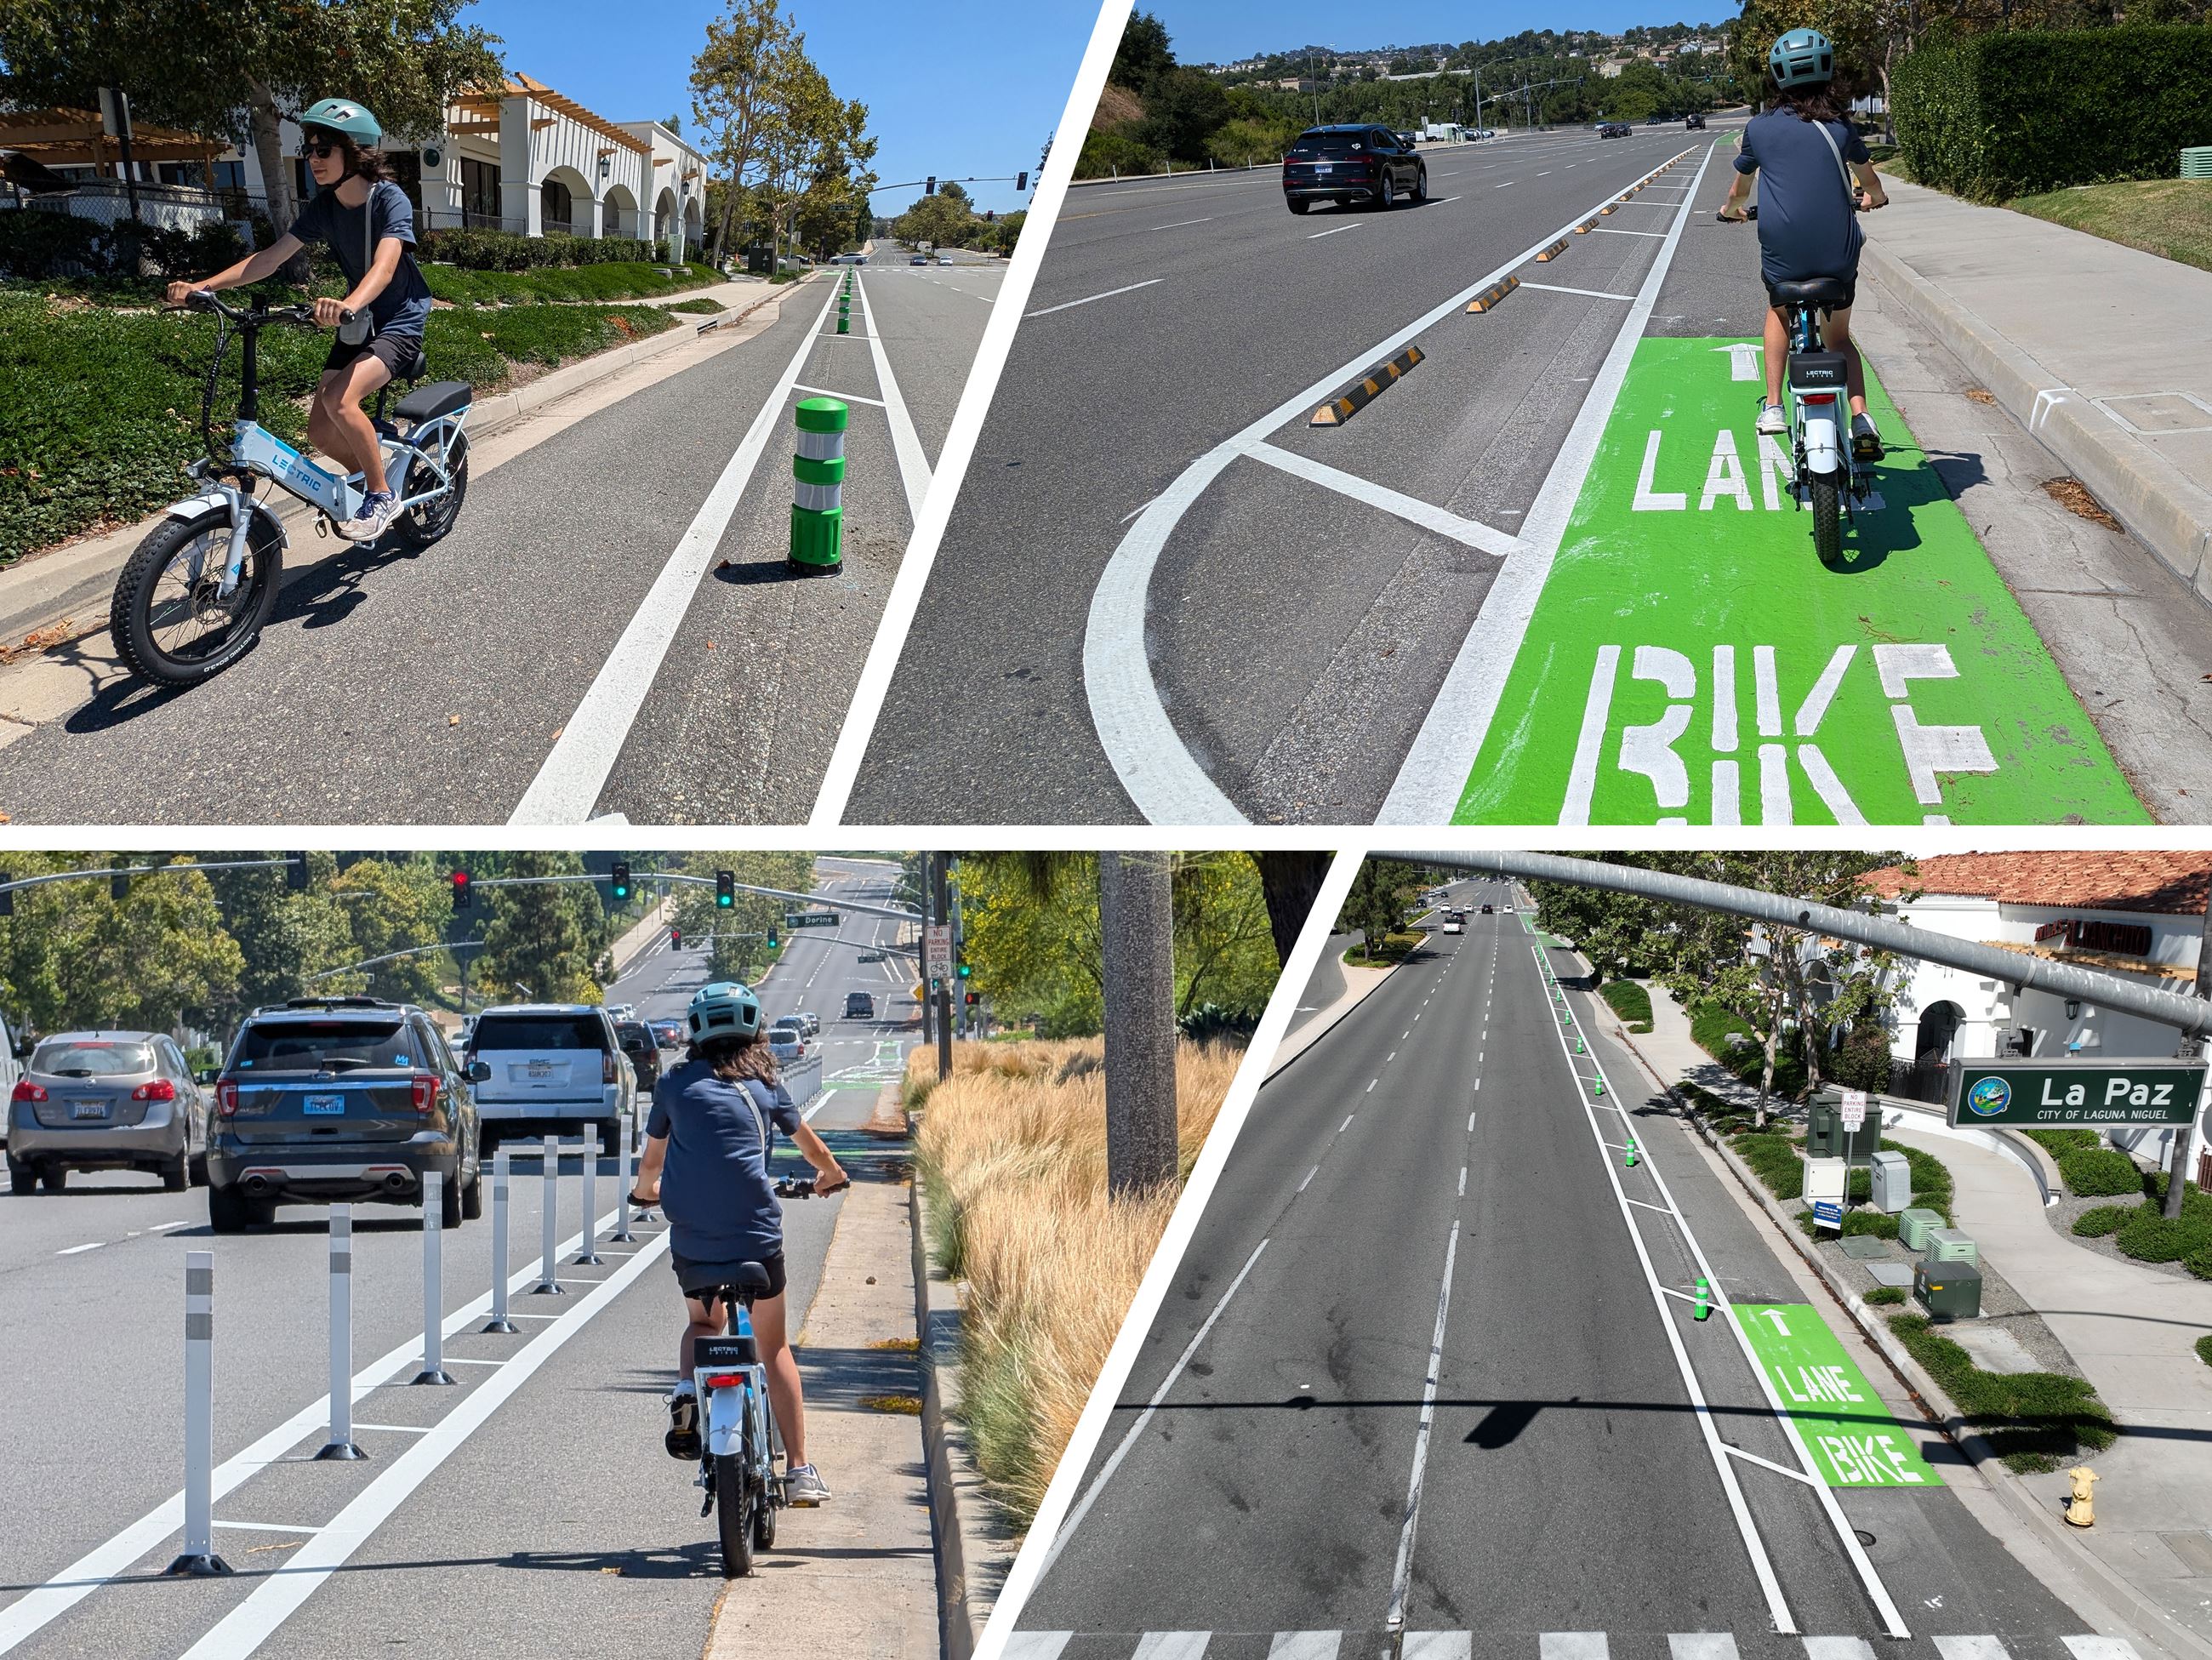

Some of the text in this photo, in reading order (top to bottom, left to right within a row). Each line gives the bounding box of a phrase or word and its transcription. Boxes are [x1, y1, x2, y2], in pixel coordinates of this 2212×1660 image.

[272, 454, 322, 491] LECTRIC
[1632, 430, 1886, 511] LAN
[229, 632, 255, 659] LECTRIC
[1559, 644, 1999, 824] BIKE
[805, 916, 833, 925] Dorine
[2082, 921, 2149, 956] RANCHITO
[2041, 1078, 2085, 1106] La
[2104, 1078, 2174, 1106] Paz
[2037, 1110, 2169, 1120] CITY OF LAGUNA NIGUEL
[1775, 1366, 1865, 1402] LANE
[1816, 1435, 1924, 1483] BIKE
